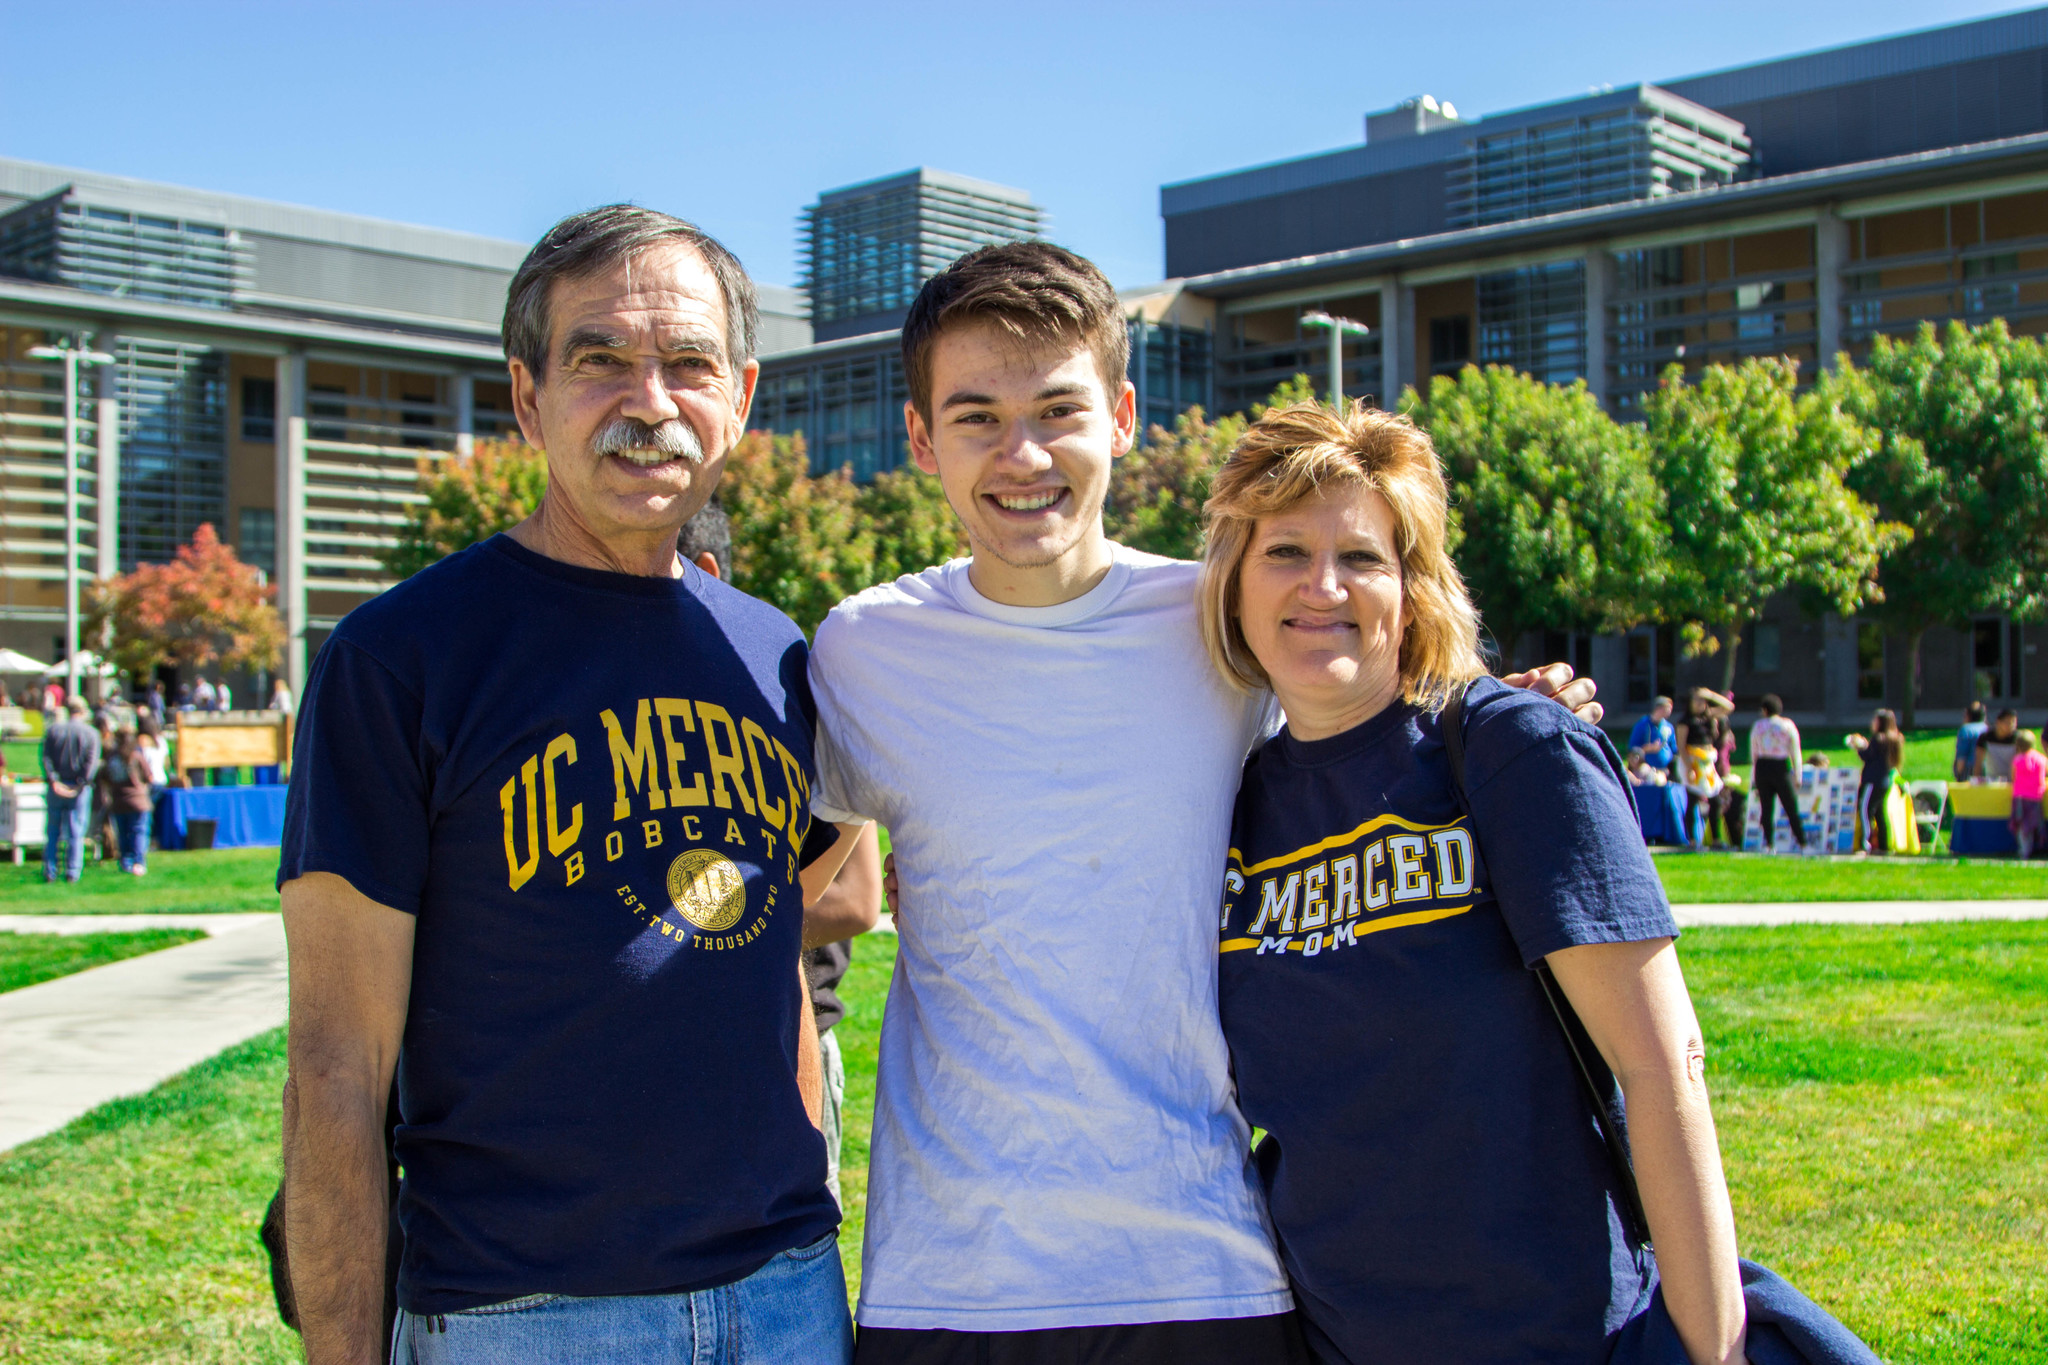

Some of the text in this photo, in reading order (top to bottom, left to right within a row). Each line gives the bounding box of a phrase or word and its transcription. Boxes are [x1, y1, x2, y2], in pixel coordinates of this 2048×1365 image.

[500, 732, 584, 893] UC
[564, 815, 795, 887] BOBCATS
[673, 854, 702, 884] UNIVERSITY
[723, 862, 740, 908] CALIFORNIA
[1247, 827, 1475, 935] MERCED
[616, 884, 779, 951] EST. TWO THOUSAND TWO
[697, 914, 730, 924] MERCED
[1256, 919, 1358, 957] MOM
